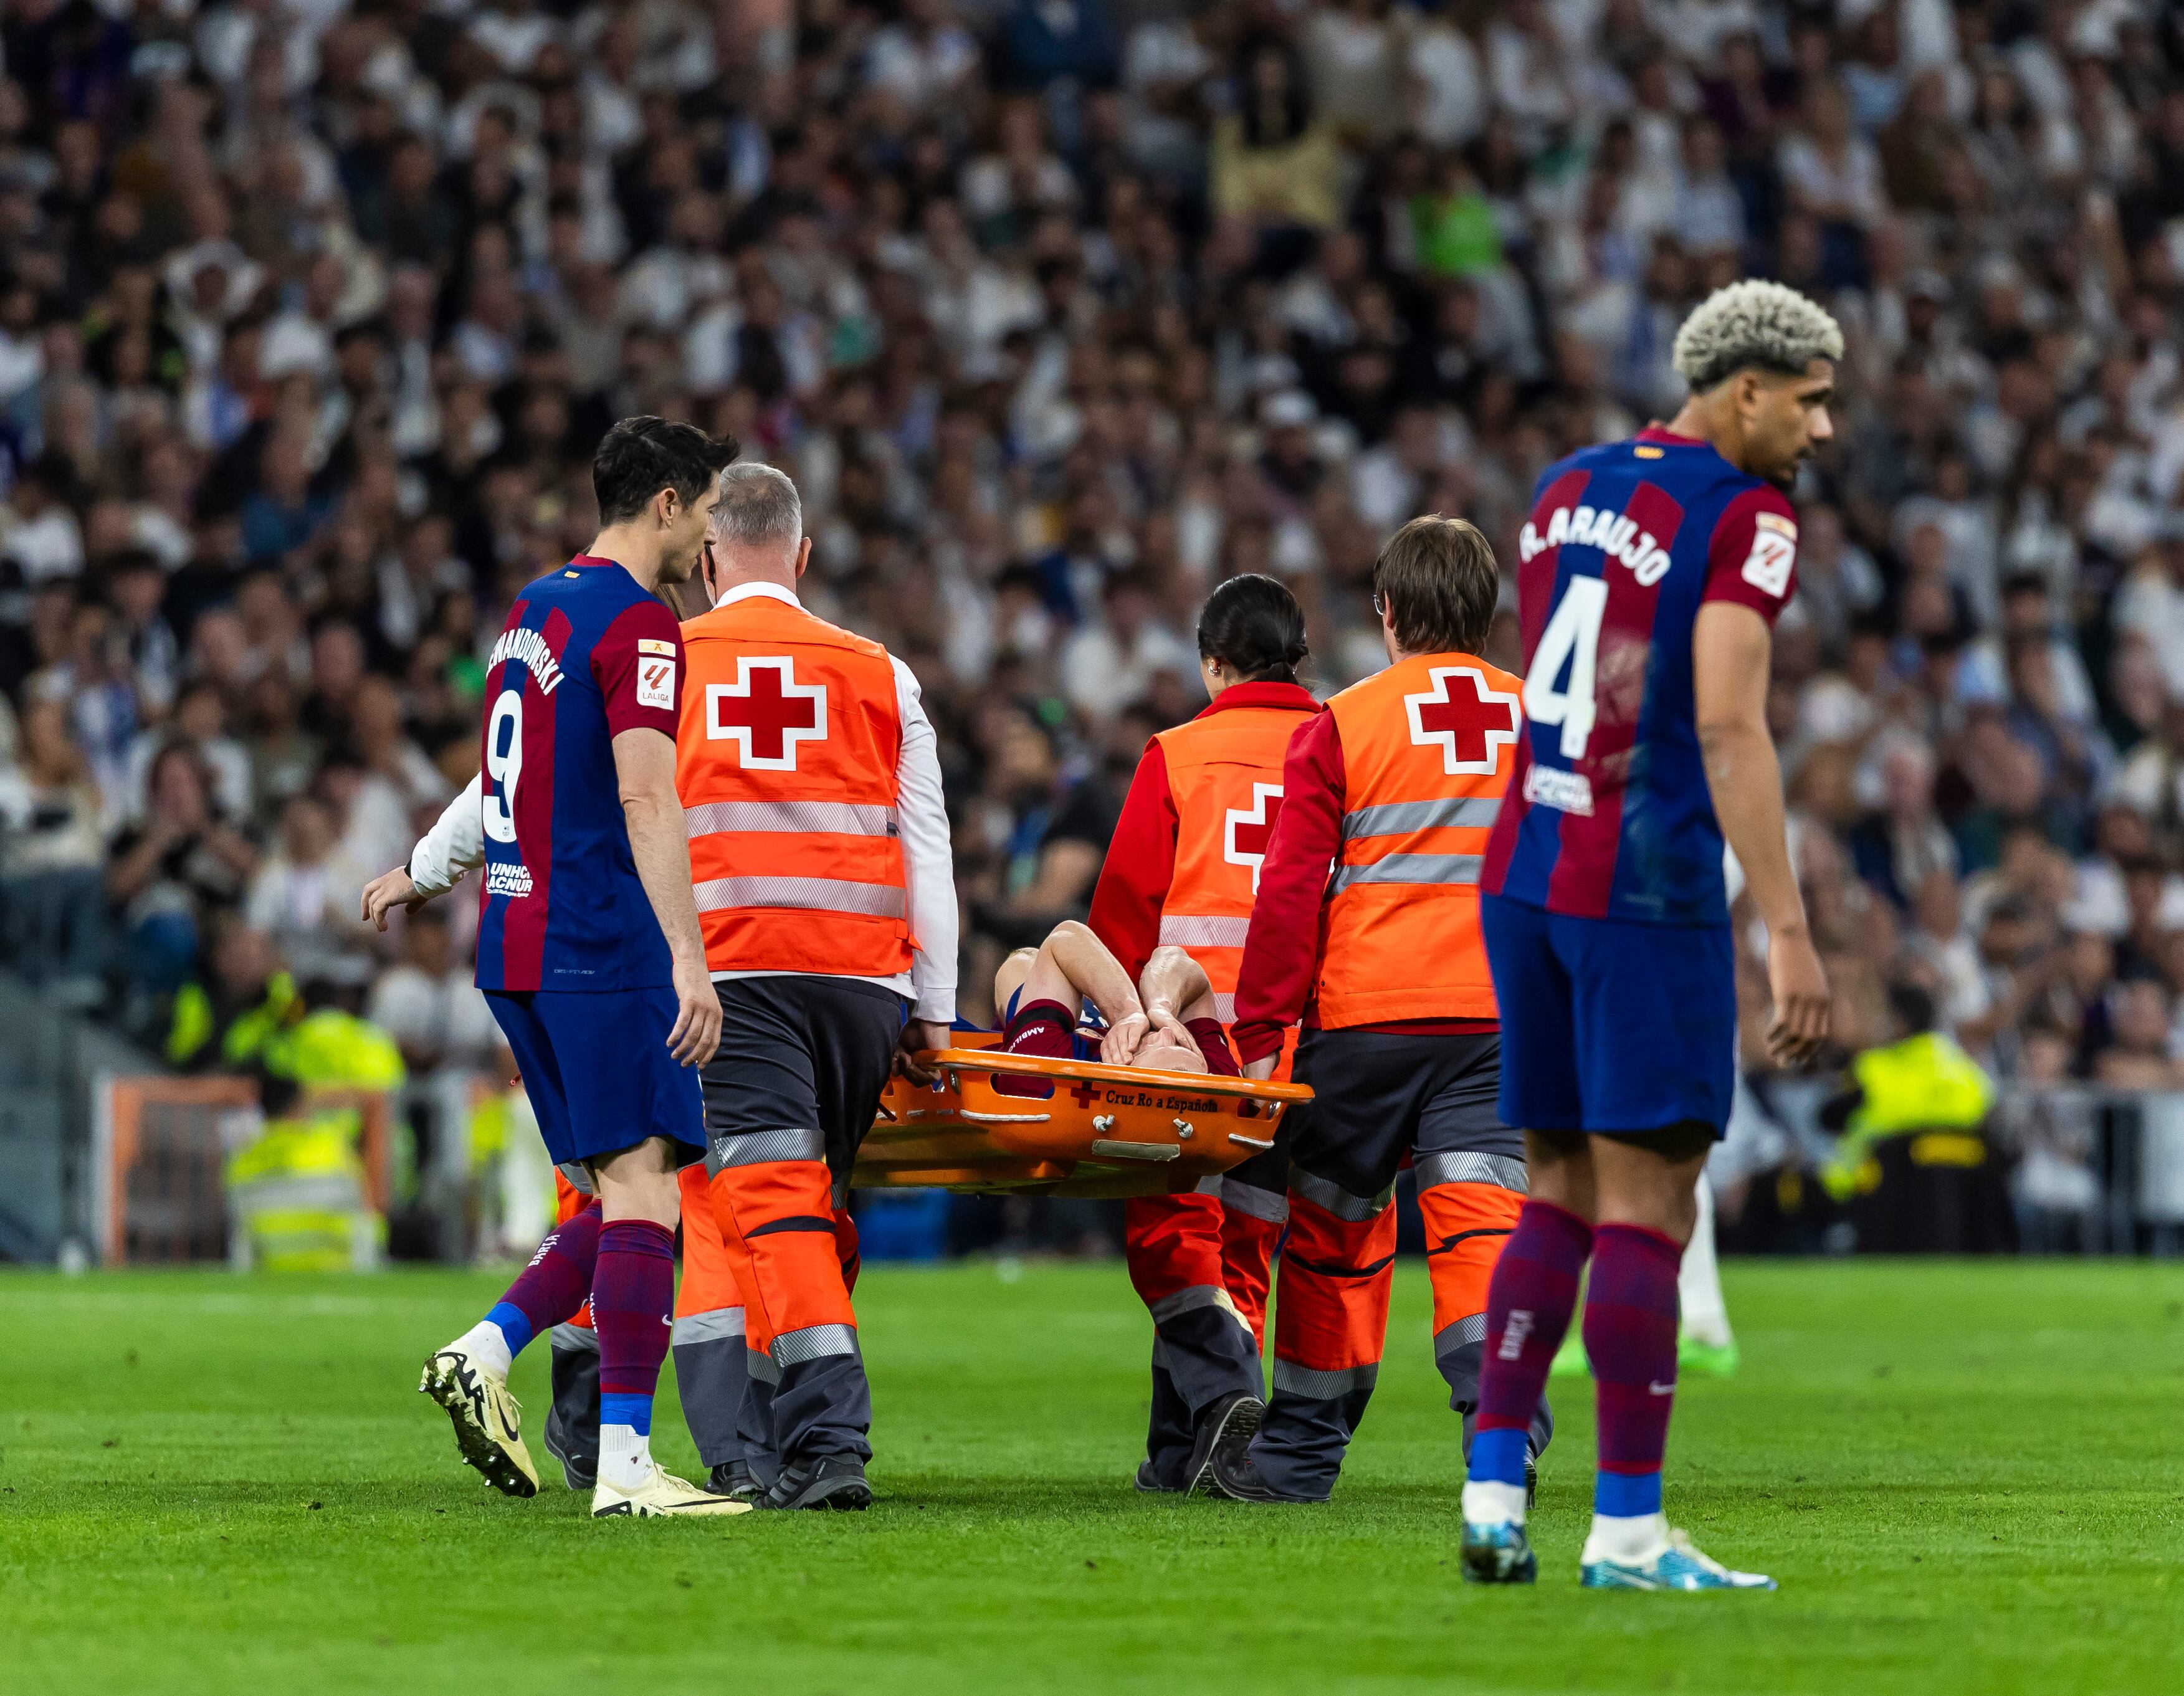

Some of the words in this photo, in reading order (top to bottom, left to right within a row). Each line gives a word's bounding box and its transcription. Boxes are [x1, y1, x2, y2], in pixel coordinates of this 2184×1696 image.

[1547, 505, 1672, 587] ARAUJO
[486, 628, 565, 696] EWANDOWSKI
[1523, 574, 1608, 760] 4
[643, 692, 669, 702] LALIGA
[483, 689, 523, 843] 9
[489, 875, 533, 892] ACNUR
[1106, 1090, 1134, 1105] Cruz
[1166, 1096, 1218, 1113] Española
[527, 1234, 560, 1267] BARÇA
